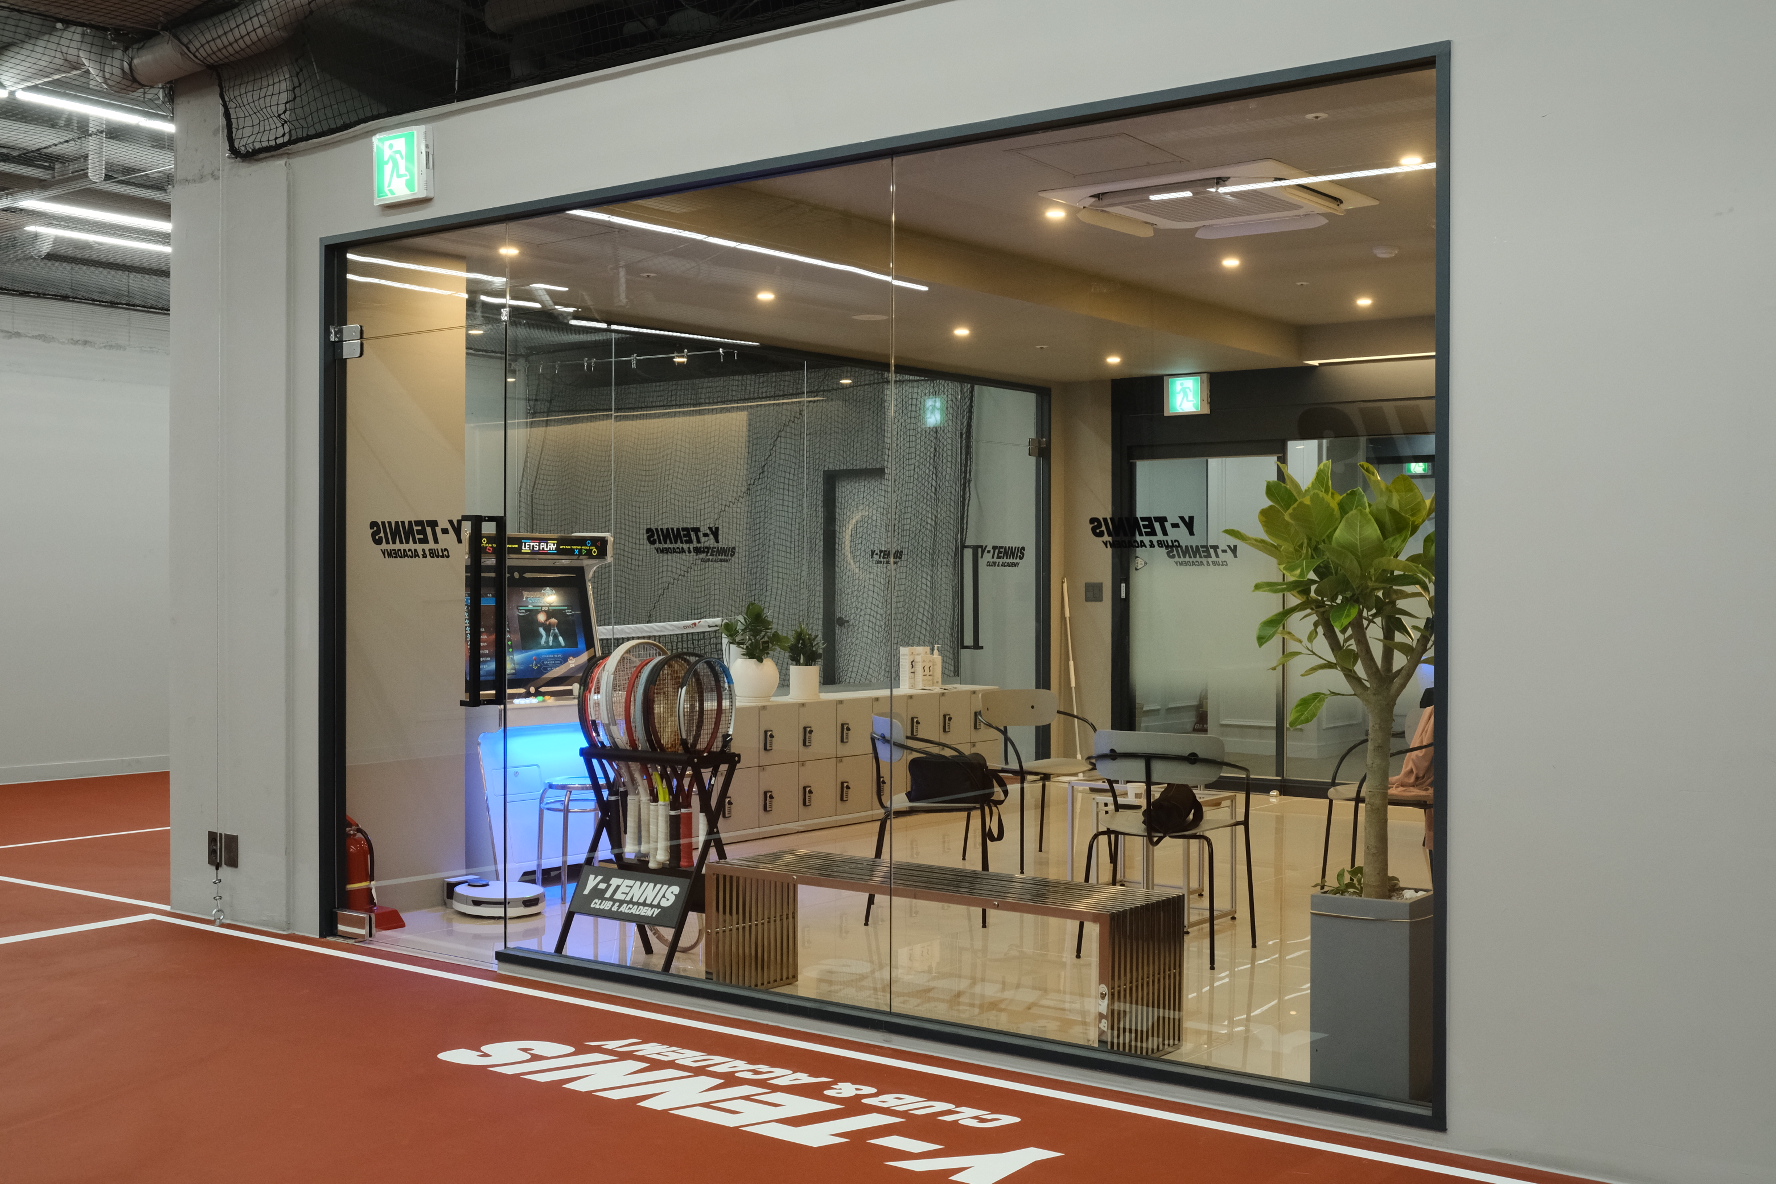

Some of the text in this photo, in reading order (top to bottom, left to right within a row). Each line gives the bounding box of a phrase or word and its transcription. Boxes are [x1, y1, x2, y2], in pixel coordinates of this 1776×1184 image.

[979, 545, 1026, 561] Y-TENNIS
[583, 874, 680, 907] Y-TENNIS
[590, 899, 661, 918] CLUB & ACADEMY
[584, 1038, 1022, 1128] CLUB & ACADEMY
[437, 1040, 1066, 1184] Y-TENNIS
